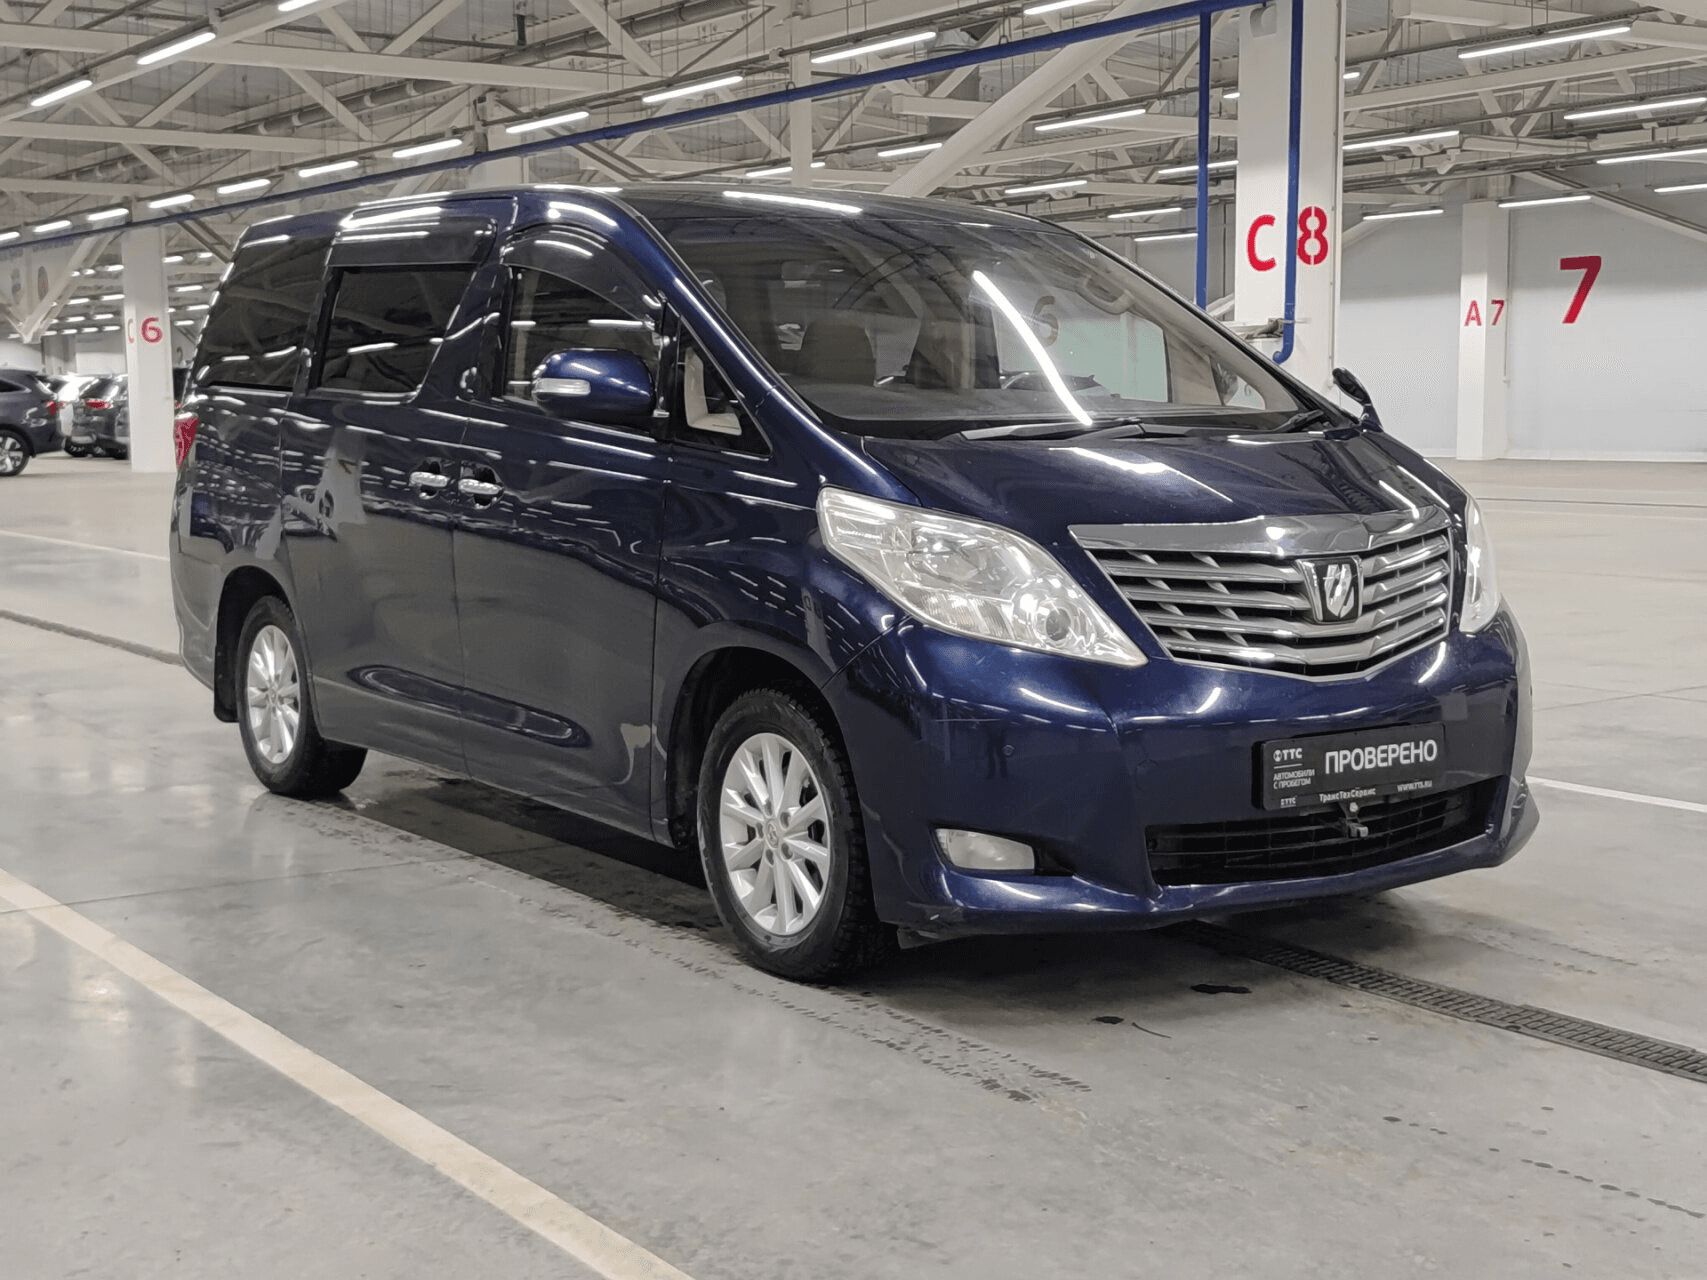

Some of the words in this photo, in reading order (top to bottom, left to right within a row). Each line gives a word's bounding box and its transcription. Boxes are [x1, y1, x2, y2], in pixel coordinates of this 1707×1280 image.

[1246, 214, 1277, 272] C
[1296, 205, 1330, 266] 8
[1560, 255, 1602, 324] 7
[1464, 299, 1482, 326] A
[1491, 299, 1505, 326] 7
[140, 316, 163, 345] 6
[1325, 739, 1438, 775] ПРОВЕРЕНО
[1273, 769, 1315, 781] АВТОМОБИЛИ
[1279, 777, 1311, 789] ПРОБЕГОМ
[1319, 788, 1376, 804] ТрансТехСервис
